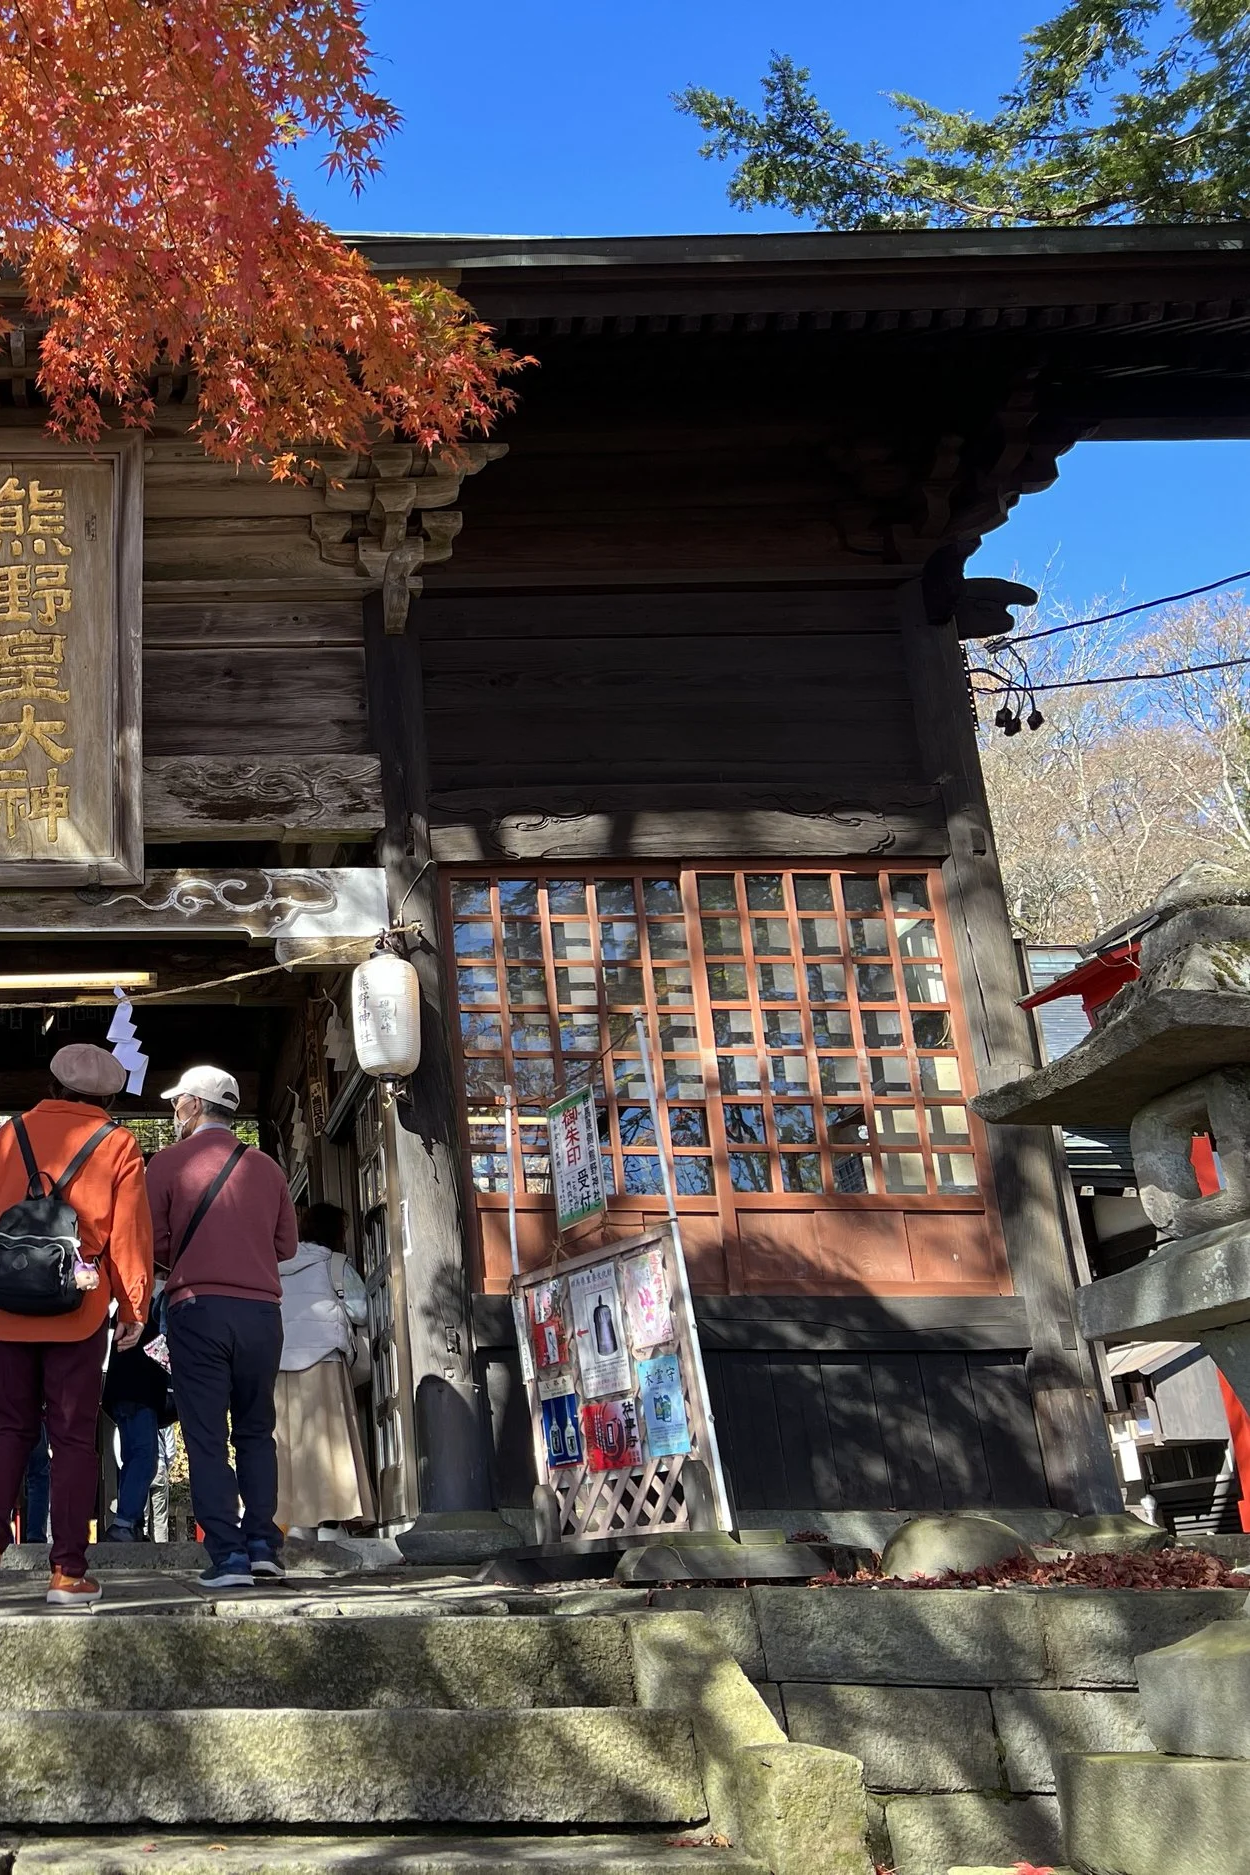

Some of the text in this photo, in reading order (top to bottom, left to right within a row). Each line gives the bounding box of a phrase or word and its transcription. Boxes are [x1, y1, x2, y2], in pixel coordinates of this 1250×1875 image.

[358, 973, 372, 1043] 熊野神社
[562, 1106, 582, 1167] 御朱印
[577, 1168, 592, 1214] 受付
